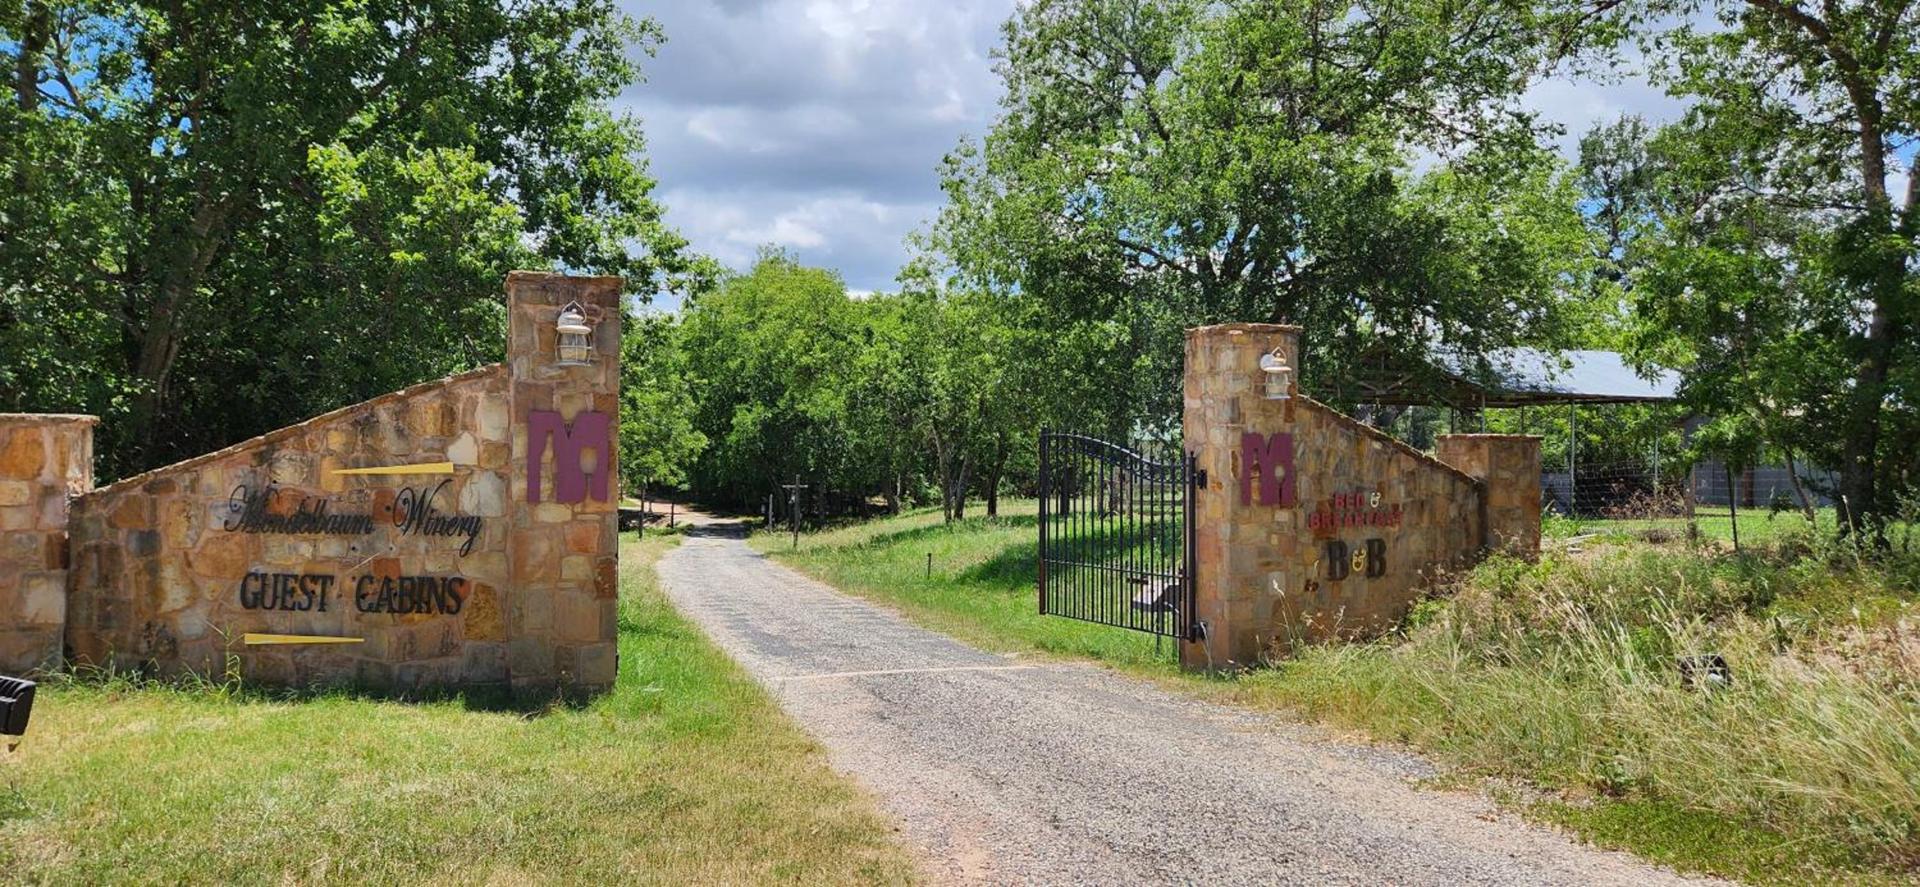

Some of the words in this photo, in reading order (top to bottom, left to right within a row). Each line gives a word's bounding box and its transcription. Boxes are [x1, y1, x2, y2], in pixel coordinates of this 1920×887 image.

[392, 478, 482, 557] Winery
[1333, 491, 1365, 509] BED
[1370, 491, 1381, 508] &
[240, 572, 334, 613] GUEST
[355, 576, 468, 615] CABINS
